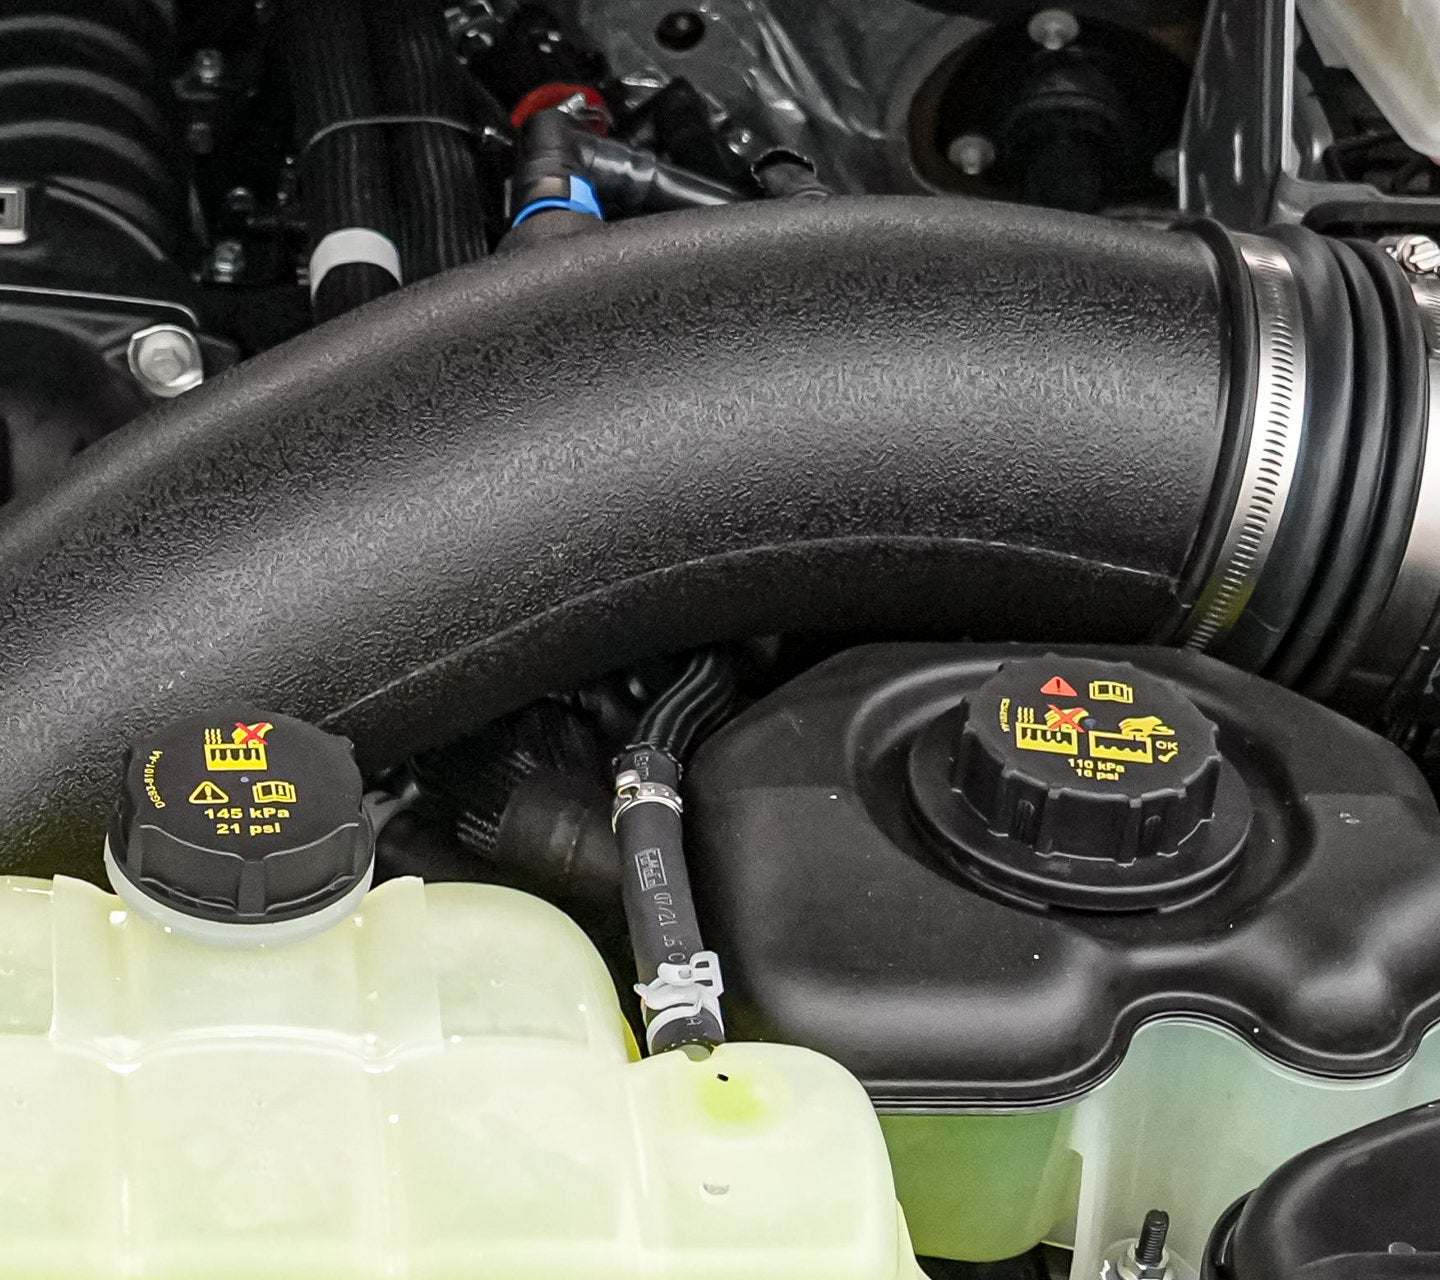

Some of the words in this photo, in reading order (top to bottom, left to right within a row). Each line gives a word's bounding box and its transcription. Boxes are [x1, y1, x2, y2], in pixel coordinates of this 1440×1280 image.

[1155, 741, 1179, 751] OK
[1068, 758, 1094, 769] 110
[1097, 761, 1126, 773] kPa
[1096, 771, 1119, 781] psi
[204, 807, 243, 820] 145
[250, 807, 290, 819] kPa
[216, 823, 241, 835] 21
[249, 822, 281, 836] psi
